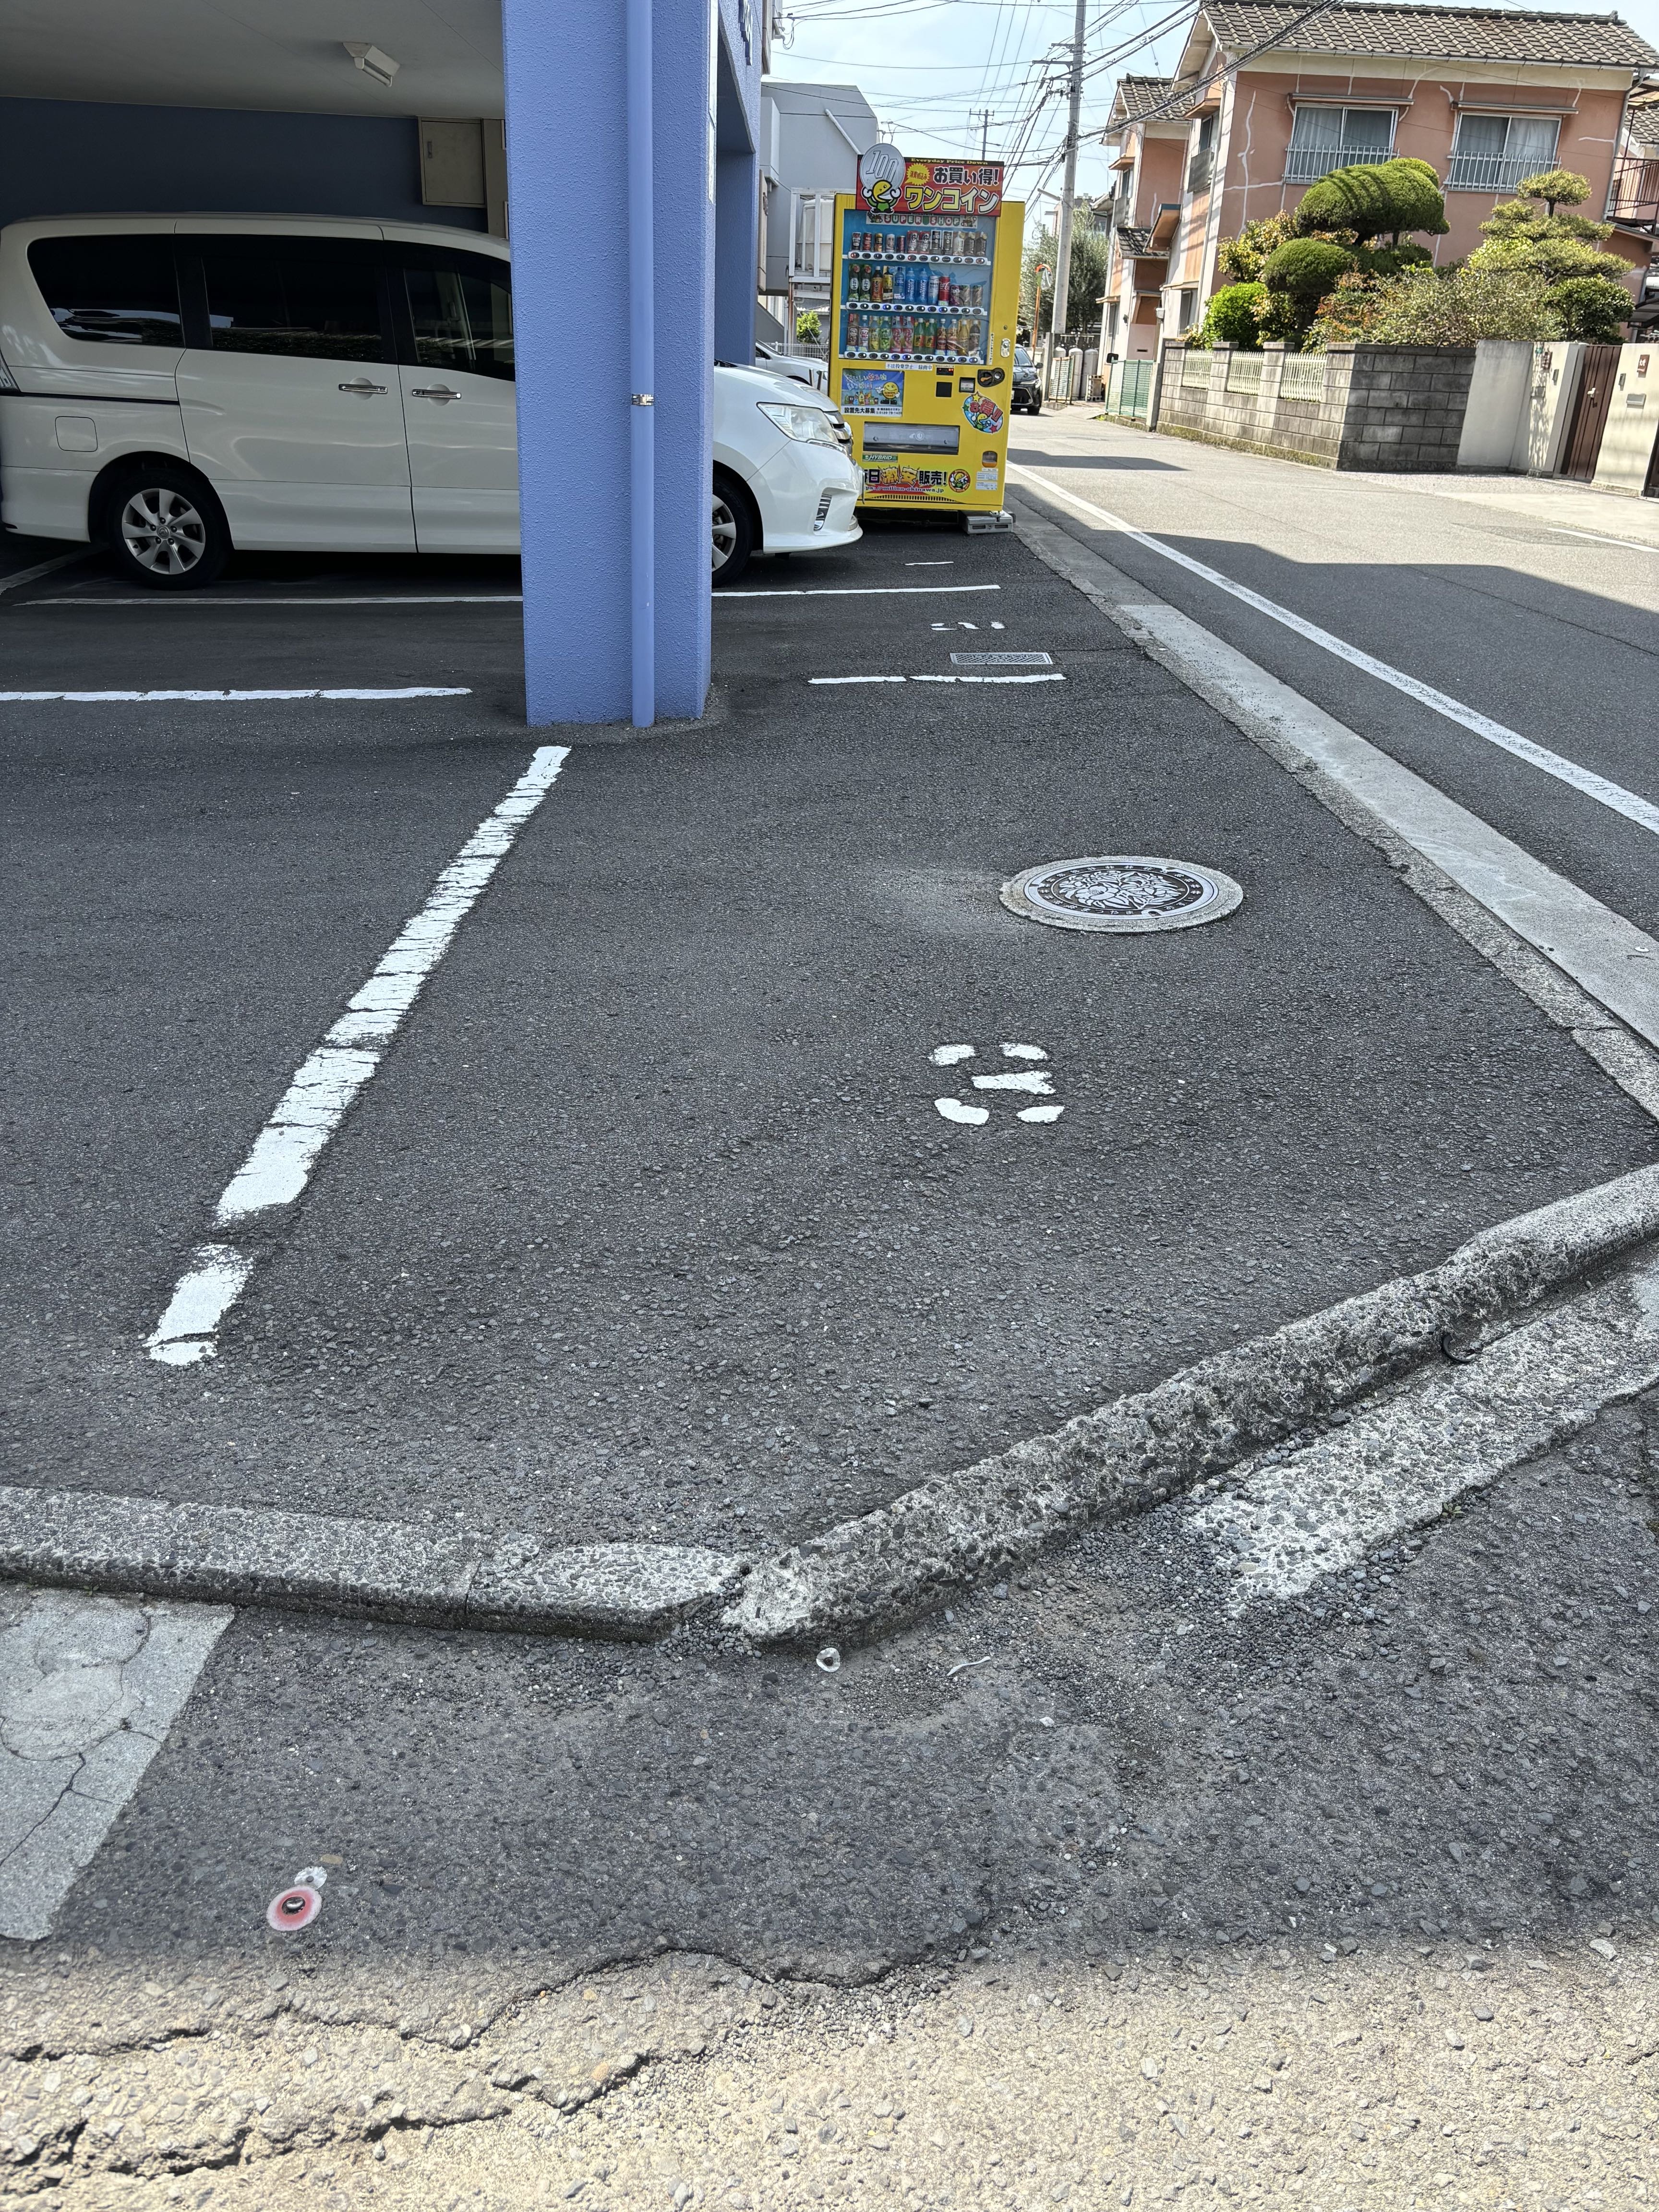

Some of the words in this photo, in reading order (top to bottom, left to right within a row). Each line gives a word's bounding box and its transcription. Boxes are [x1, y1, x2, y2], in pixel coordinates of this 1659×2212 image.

[866, 151, 899, 182] 100
[934, 167, 999, 186] お買い得!
[905, 186, 999, 214] ワンコイン
[885, 214, 922, 224] SUPER
[930, 216, 960, 226] SHOP
